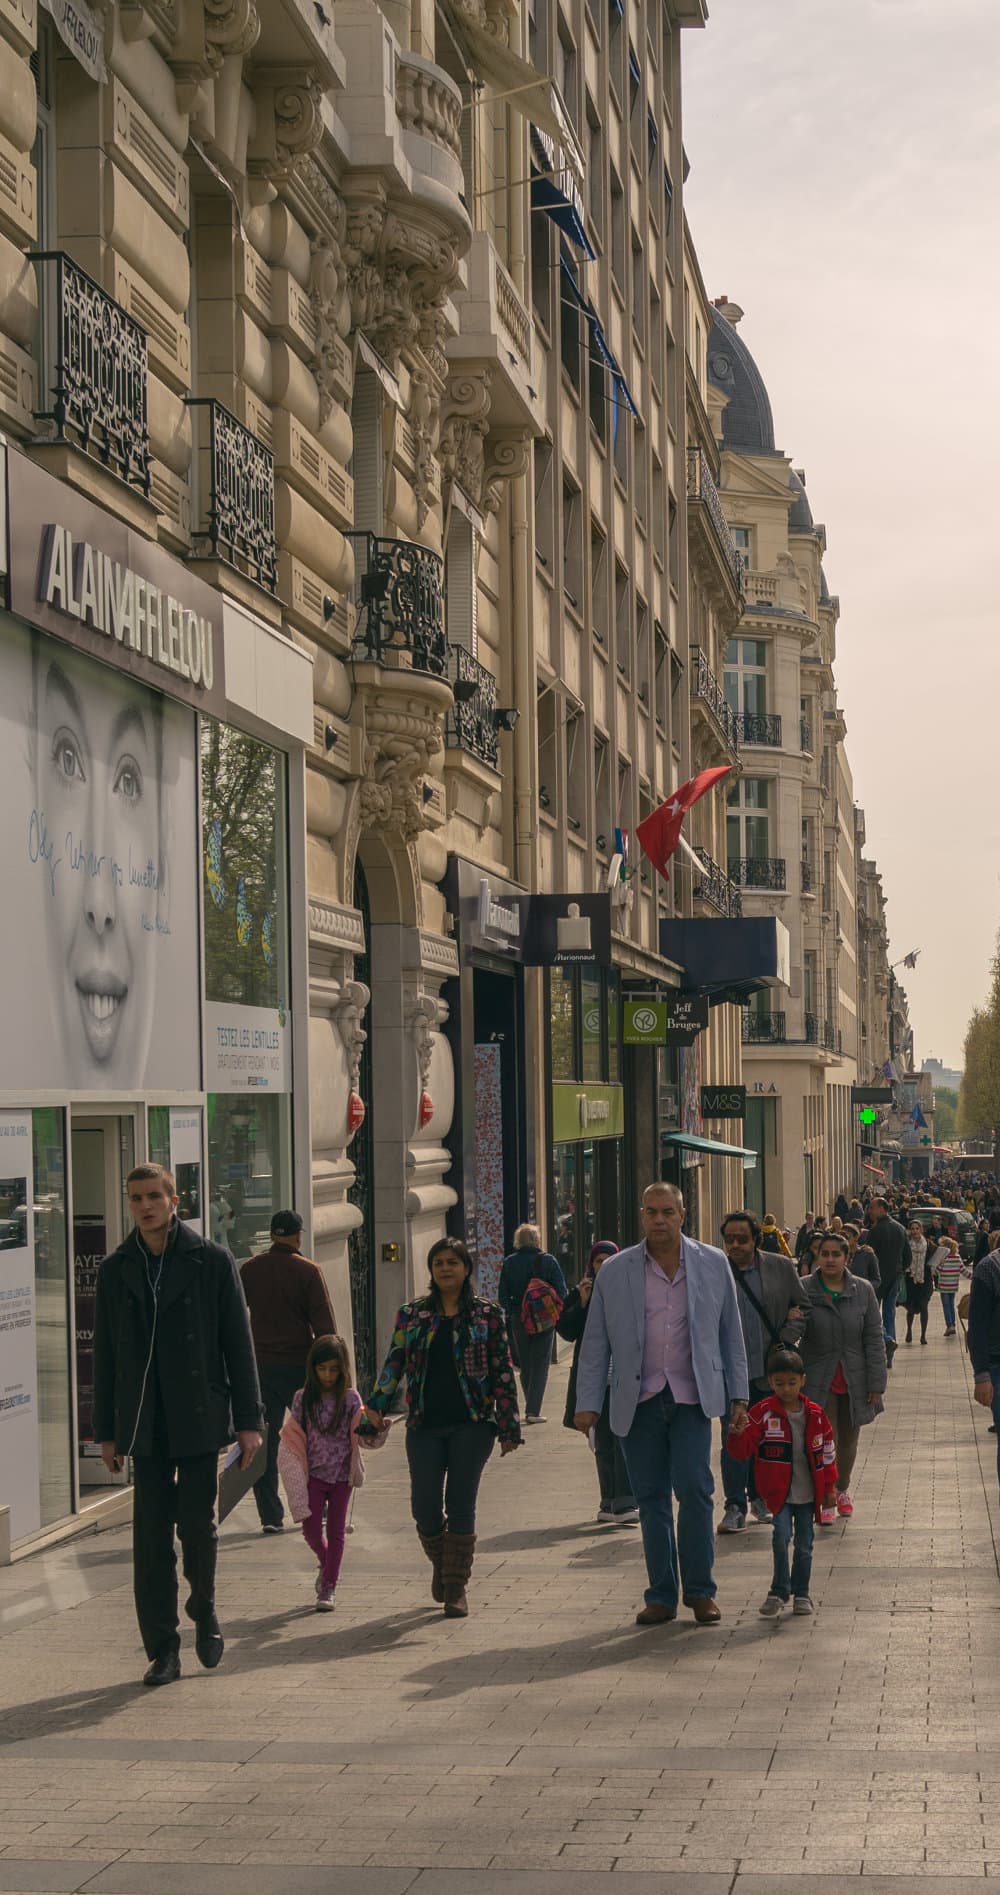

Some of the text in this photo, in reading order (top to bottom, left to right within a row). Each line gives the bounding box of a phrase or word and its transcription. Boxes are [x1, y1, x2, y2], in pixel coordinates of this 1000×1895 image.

[553, 952, 595, 962] Marionnaud
[673, 1002, 692, 1015] Jeff
[667, 1018, 701, 1032] Bruges
[251, 1030, 279, 1049] LENTILLES
[703, 1094, 742, 1110] M&S
